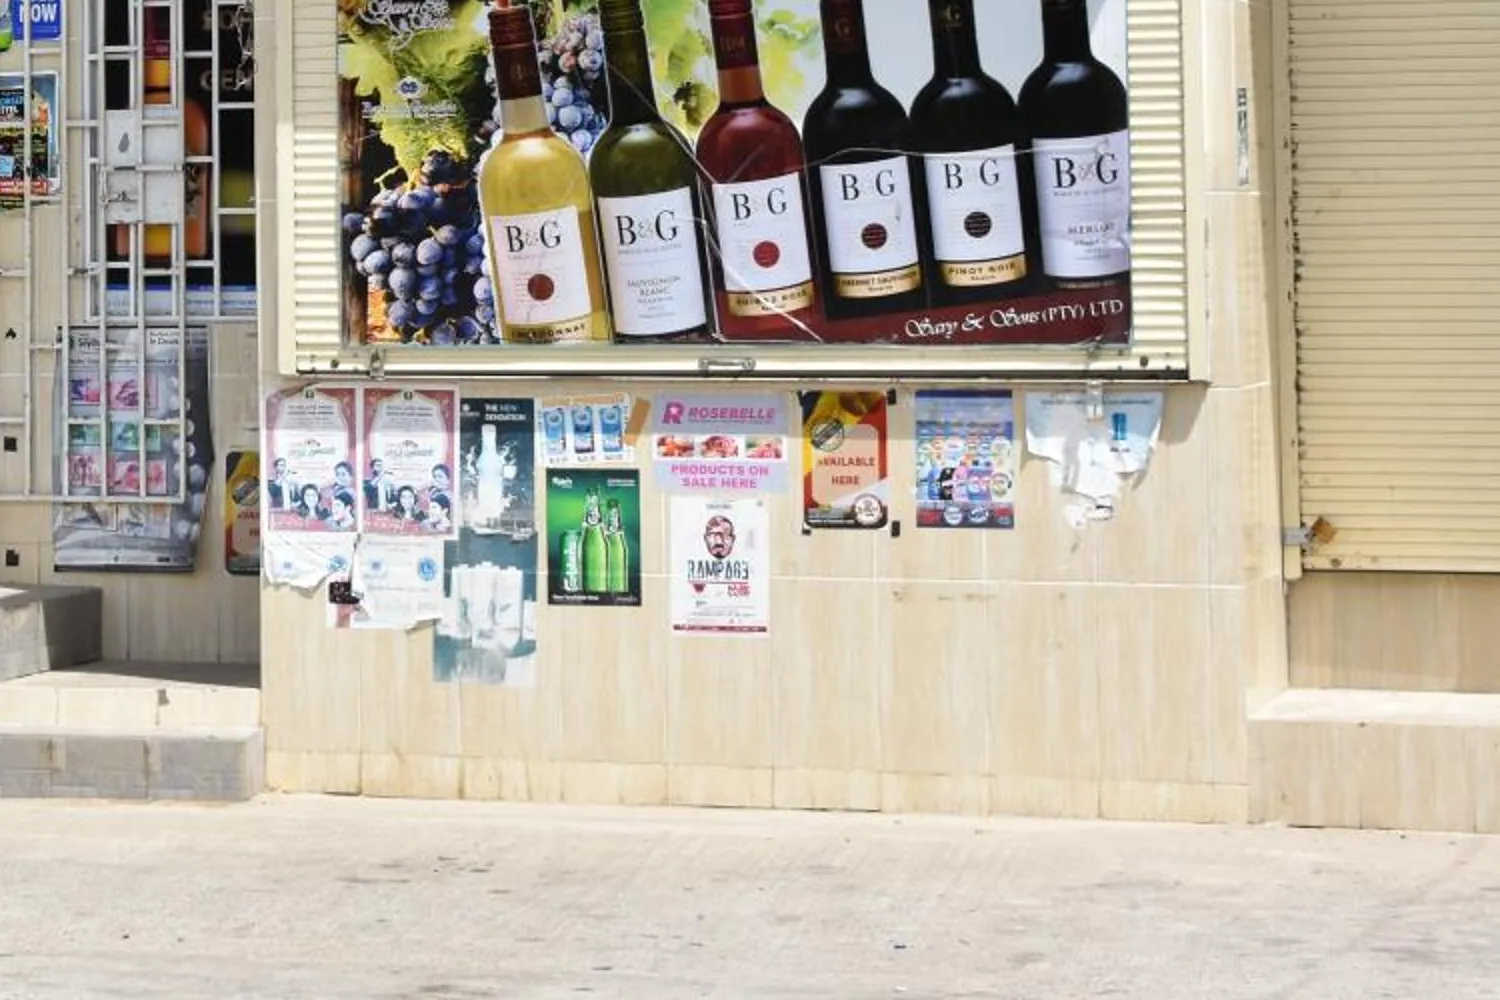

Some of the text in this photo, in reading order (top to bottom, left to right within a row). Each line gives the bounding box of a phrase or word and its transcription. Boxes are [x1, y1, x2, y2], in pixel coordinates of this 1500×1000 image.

[961, 312, 985, 333] &
[1089, 298, 1125, 318] LTD
[687, 406, 776, 420] ROSEBELLE
[817, 456, 876, 468] AVAILABLE
[670, 463, 770, 477] PRODUCTS ON
[680, 477, 758, 489] SALE HERE
[831, 475, 861, 486] HERE
